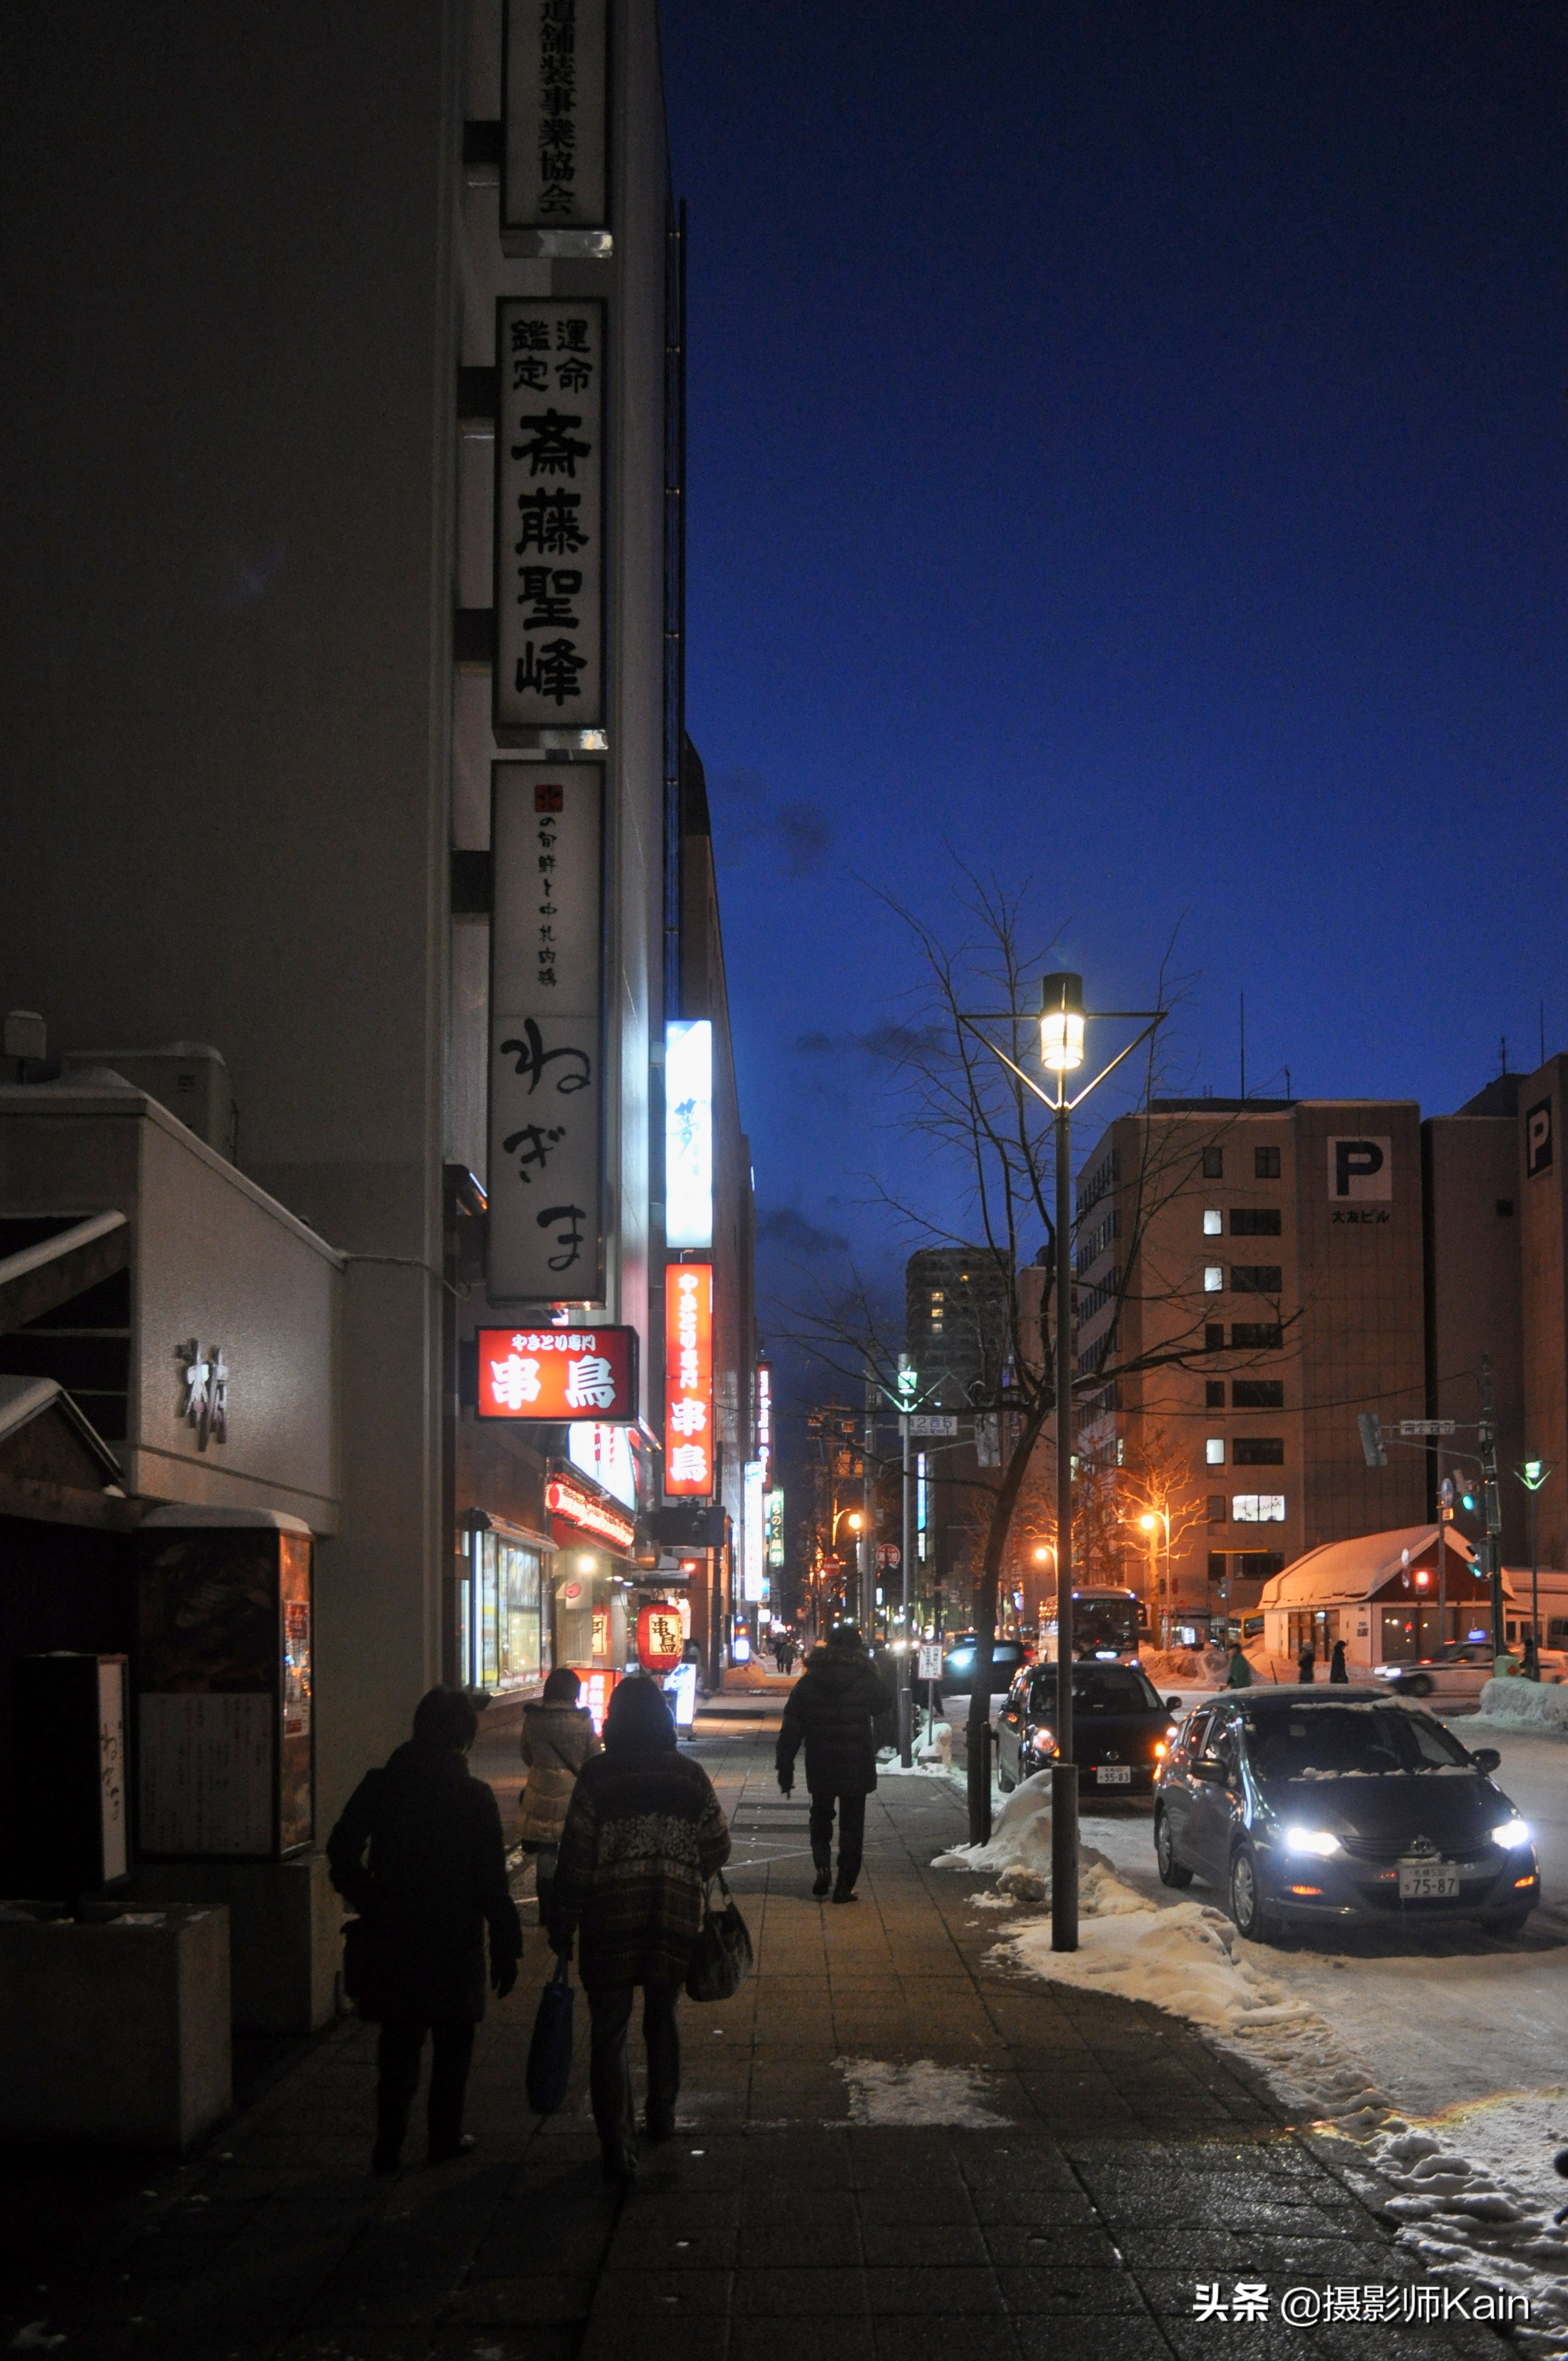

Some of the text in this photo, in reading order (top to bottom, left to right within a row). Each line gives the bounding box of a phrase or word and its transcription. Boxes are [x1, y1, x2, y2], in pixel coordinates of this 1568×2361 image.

[511, 319, 552, 392] 鑑定
[555, 319, 594, 394] 運命
[500, 1018, 590, 1271] ねぎま
[1530, 1108, 1549, 1169] P
[1336, 1141, 1384, 1195] P
[511, 1334, 596, 1352] やきとり専門
[678, 1273, 698, 1389] やきとり専門
[491, 1354, 616, 1410] 串鳥
[670, 1397, 707, 1482] 串鳥
[652, 1617, 676, 1653] 串鳥
[1104, 1773, 1129, 1782] 95-83
[1413, 1878, 1455, 1894] 75-87
